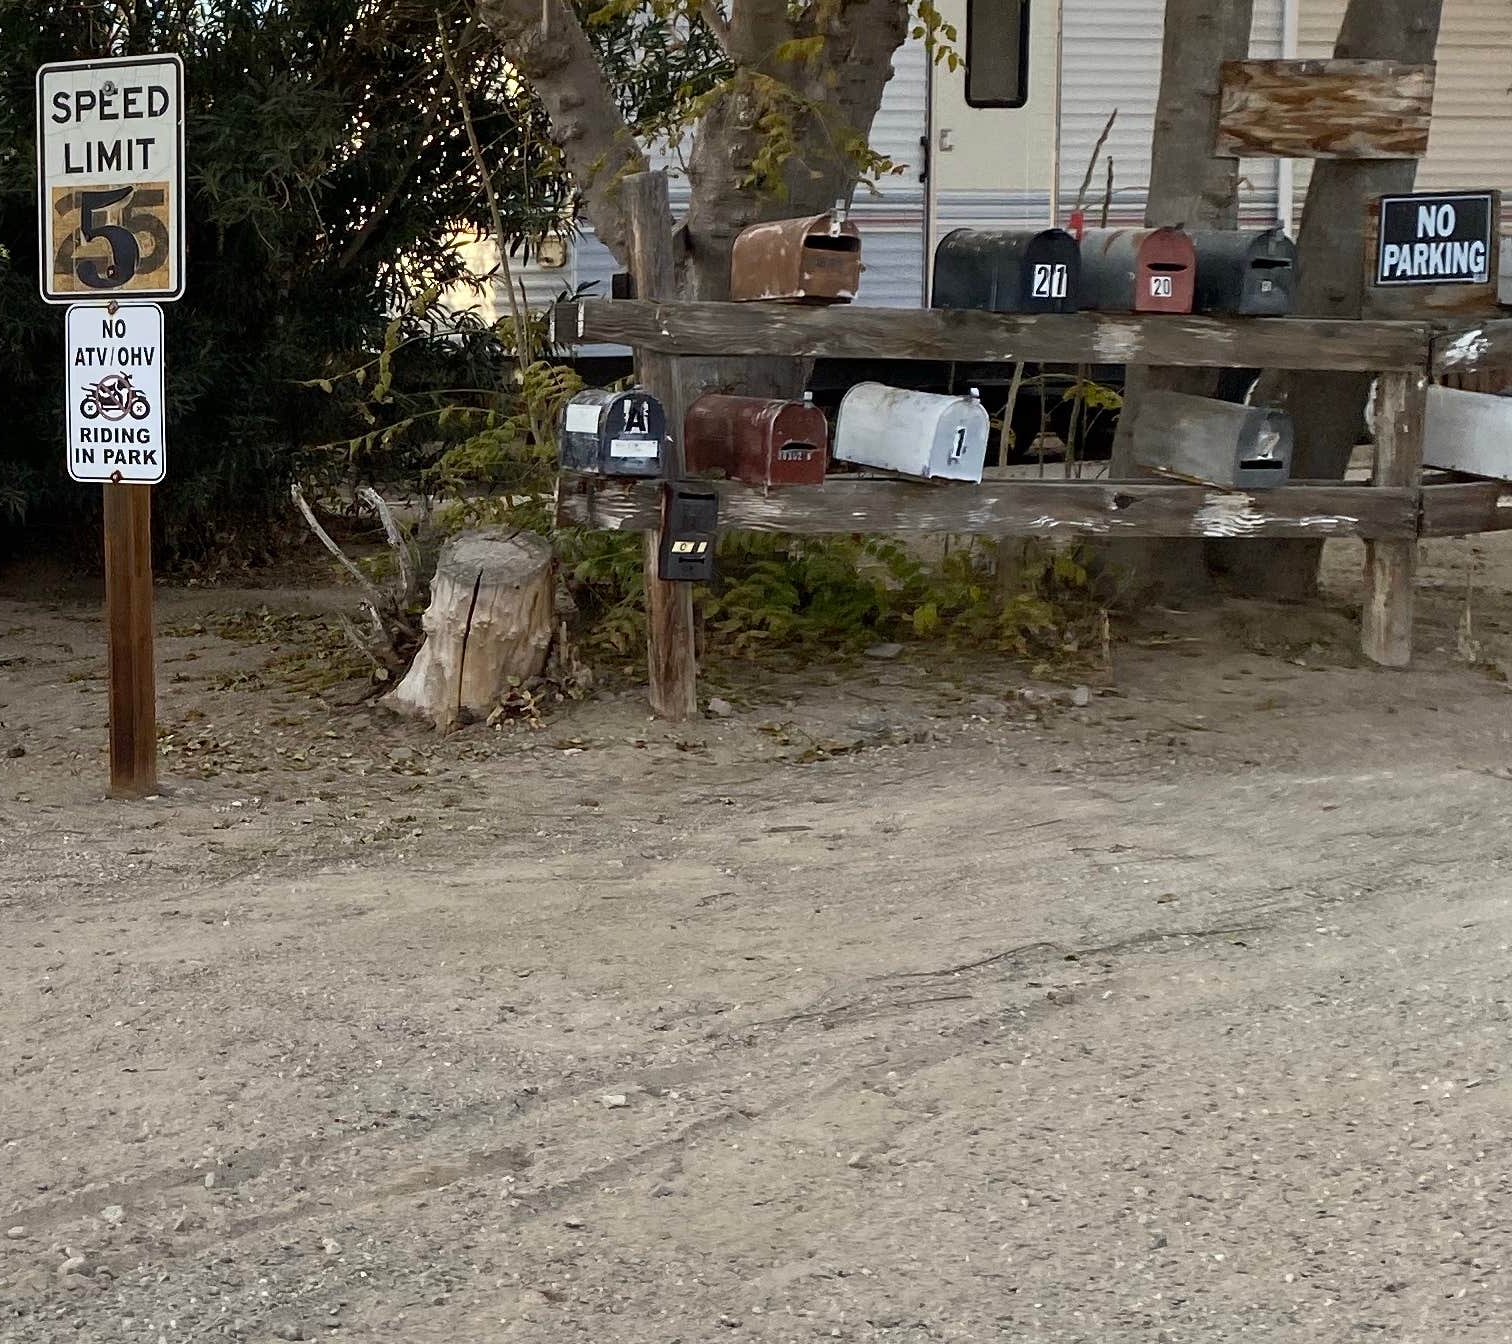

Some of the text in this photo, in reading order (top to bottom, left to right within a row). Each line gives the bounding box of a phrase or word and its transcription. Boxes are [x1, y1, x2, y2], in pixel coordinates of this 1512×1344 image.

[51, 85, 169, 124] SPEED
[64, 137, 156, 174] LIMIT
[1416, 203, 1456, 238] NO
[1382, 240, 1485, 277] PARKING
[1035, 265, 1066, 296] 21
[1153, 278, 1171, 296] 20
[102, 318, 127, 339] NO
[74, 346, 155, 367] ATV/OHV
[624, 399, 648, 432] A
[80, 427, 151, 444] RIDING
[955, 427, 966, 457] 1
[75, 448, 95, 464] IN
[103, 448, 158, 466] PARK
